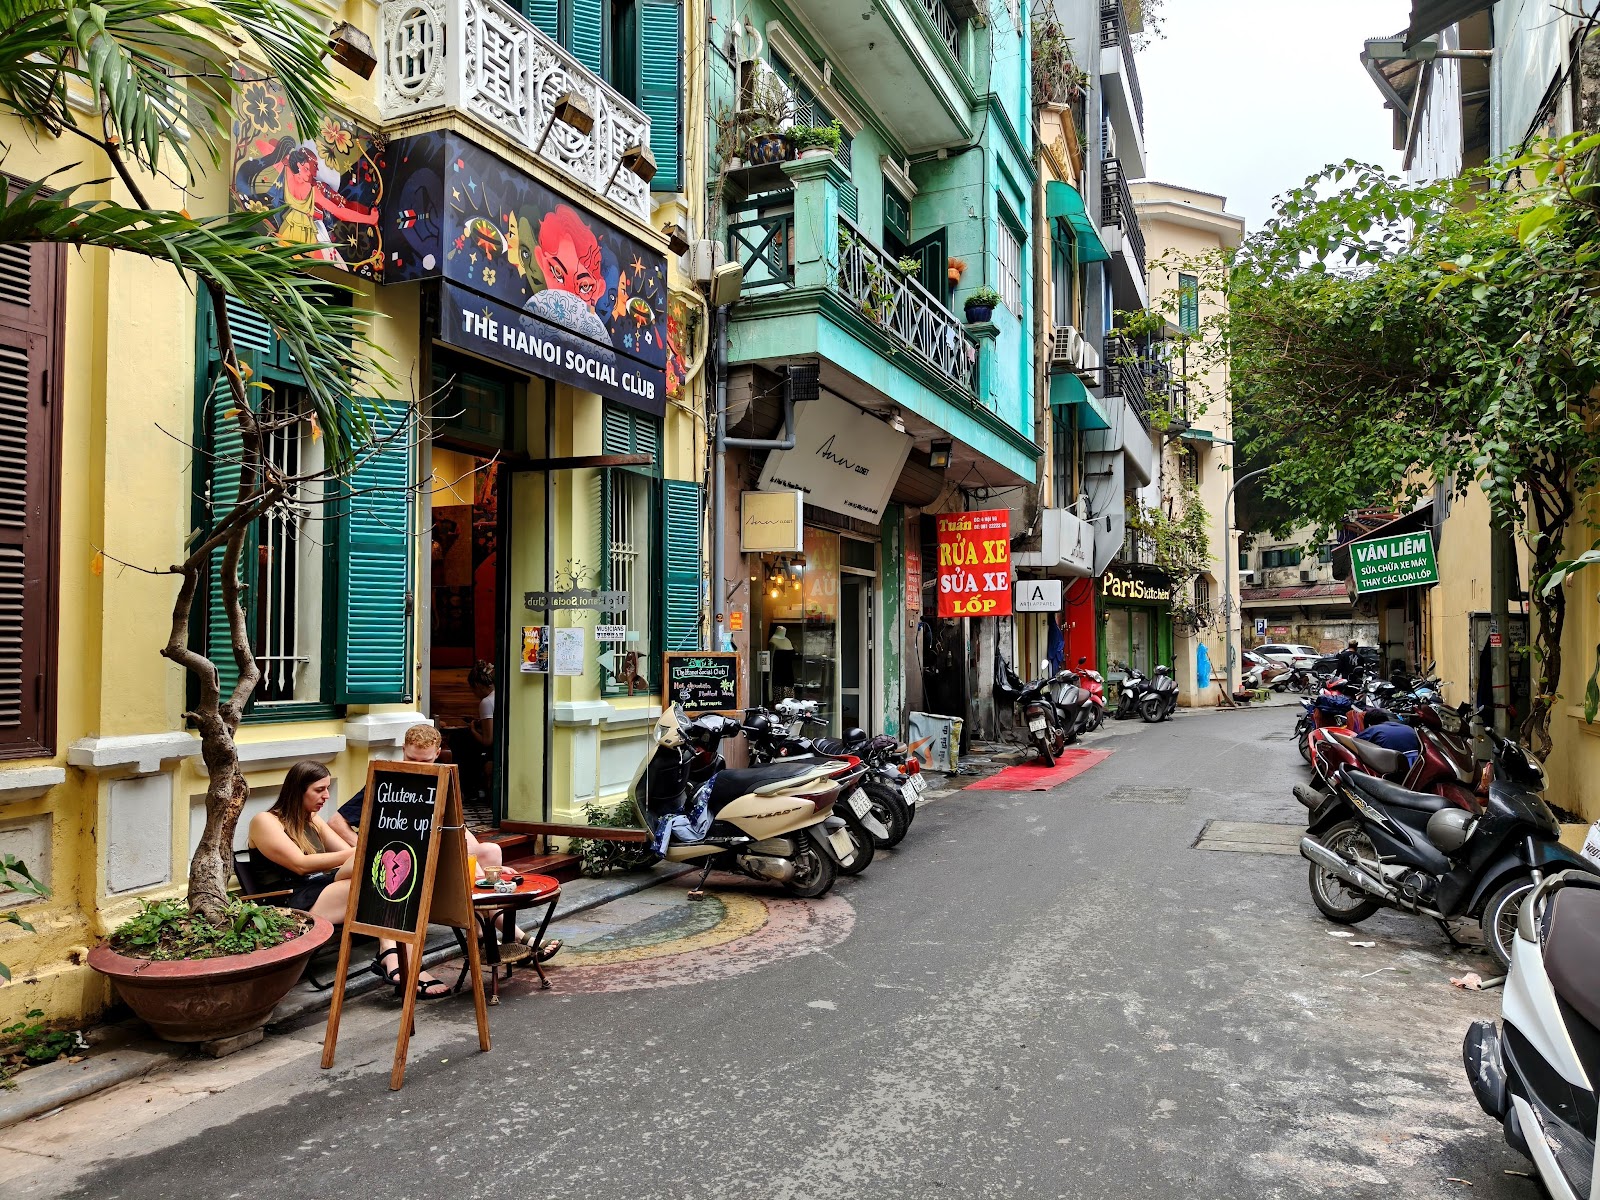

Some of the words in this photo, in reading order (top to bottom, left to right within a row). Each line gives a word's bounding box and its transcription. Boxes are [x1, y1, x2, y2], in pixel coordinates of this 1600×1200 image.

[462, 309, 498, 342] THE
[502, 325, 561, 366] HANOI
[565, 350, 618, 387] SOCIAL
[621, 373, 655, 400] CLUB
[854, 465, 869, 476] CLOSET
[939, 516, 972, 532] Tuấn
[940, 533, 979, 566] RỬA
[982, 539, 1008, 564] XE
[1356, 543, 1388, 563] VÂN
[1390, 537, 1427, 558] LIÊM
[1377, 561, 1400, 573] CHỮA
[1400, 560, 1410, 570] XE
[1411, 557, 1428, 568] MÁY
[940, 567, 979, 593] SỬA
[982, 572, 1008, 592] XE
[1361, 577, 1381, 588] THAY
[1382, 575, 1397, 585] CÁC
[1398, 572, 1416, 583] LOẠI
[1416, 568, 1432, 579] LỐP
[1031, 585, 1044, 601] A
[1144, 584, 1170, 600] kitchen
[953, 594, 997, 614] LỐP
[1258, 622, 1263, 631] P
[698, 699, 722, 707] Turmeric
[377, 782, 418, 804] Gluten
[425, 787, 436, 804] I
[378, 807, 408, 831] broke
